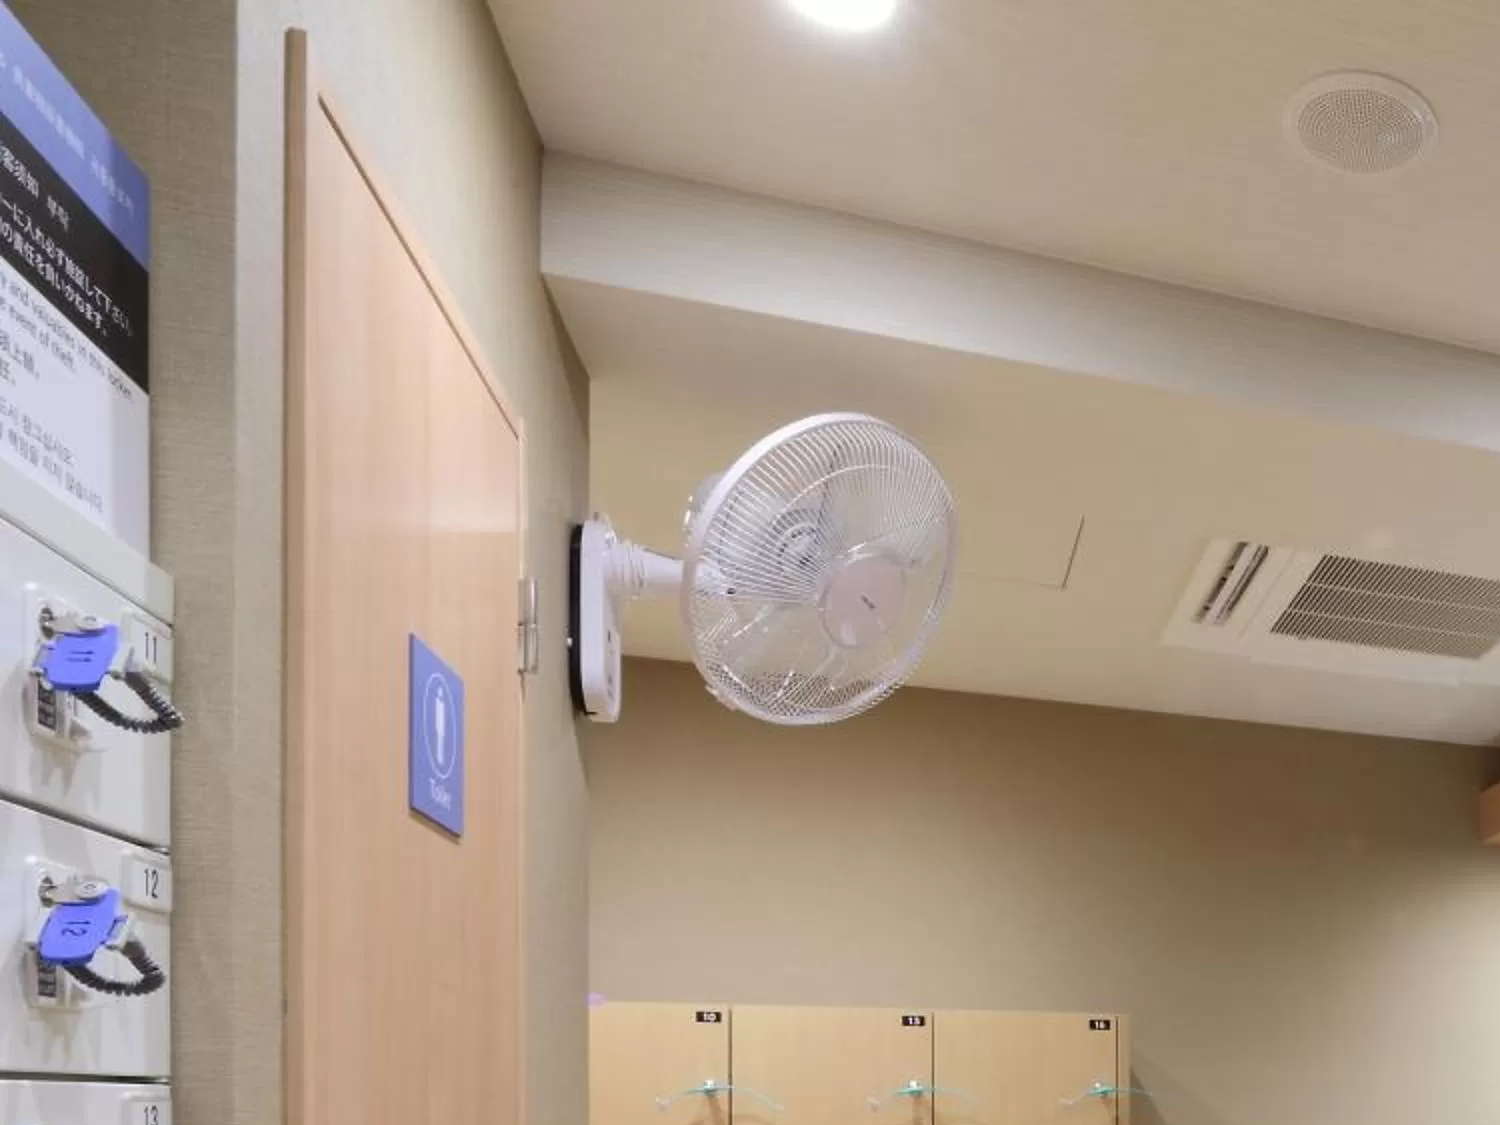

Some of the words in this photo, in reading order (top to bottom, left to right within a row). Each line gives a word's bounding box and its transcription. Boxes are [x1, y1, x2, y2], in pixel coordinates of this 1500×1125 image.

[0, 217, 107, 337] の責任を負いかねます。
[66, 650, 94, 662] 11
[145, 632, 157, 664] 11
[144, 868, 159, 899] 12
[62, 920, 91, 937] 12
